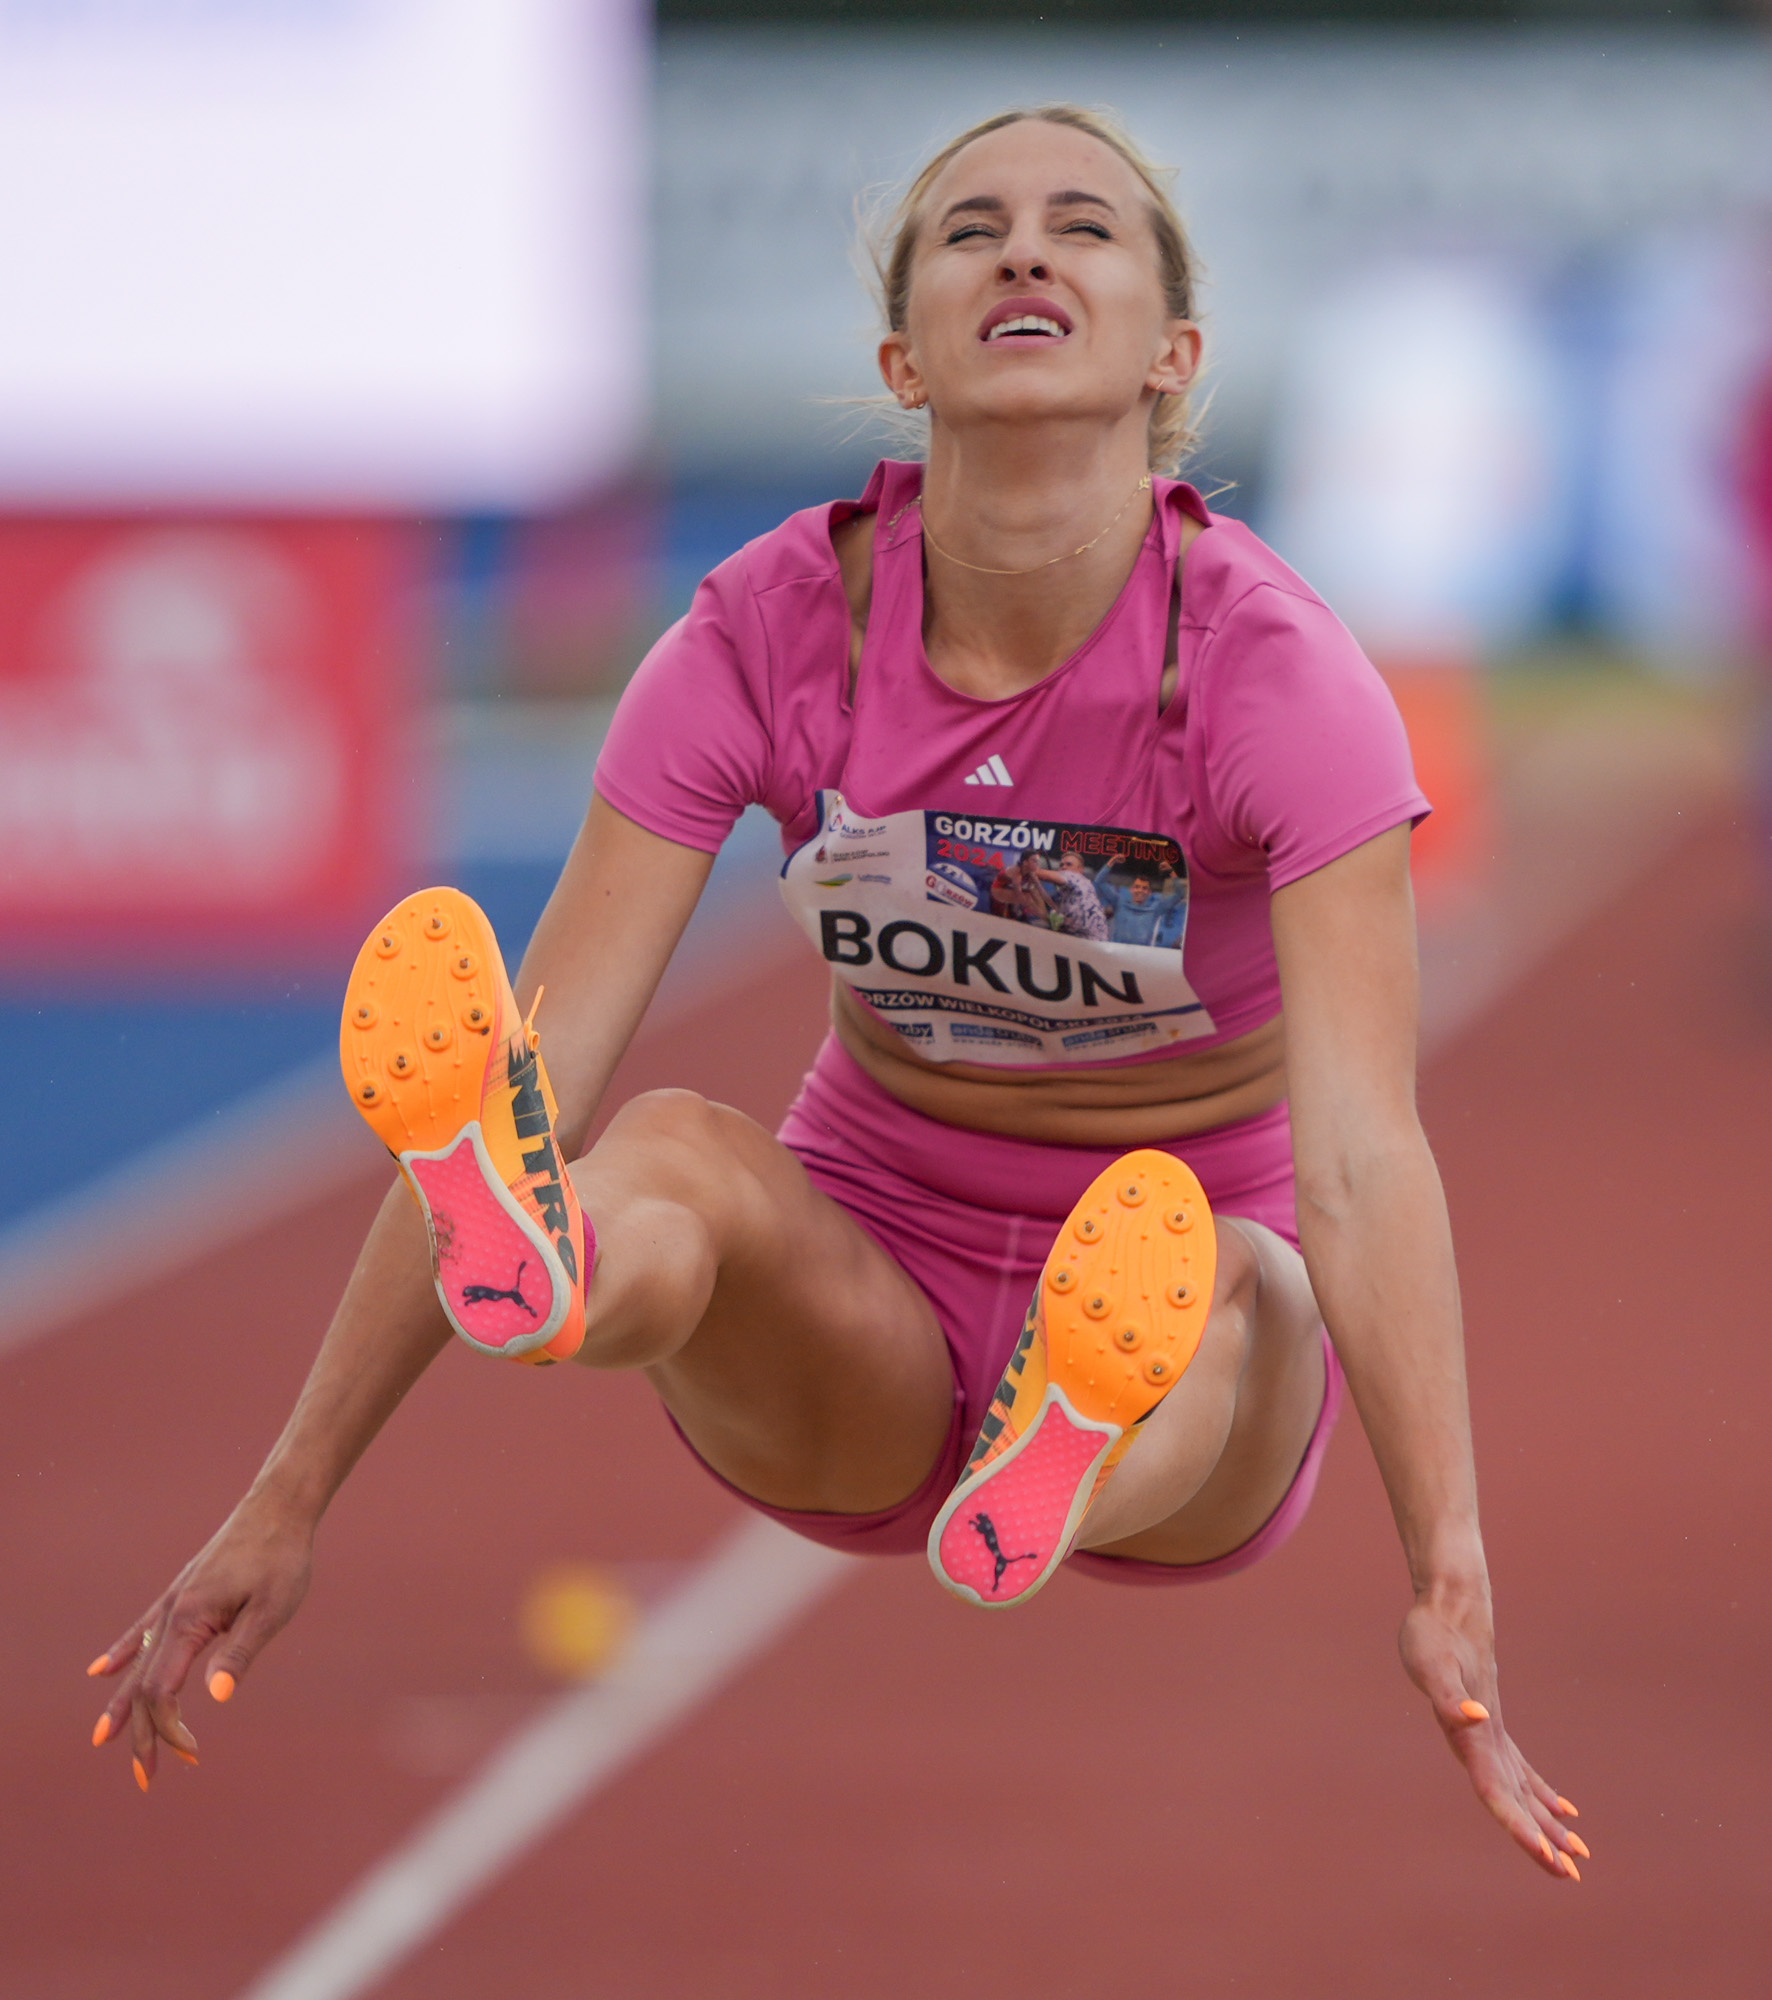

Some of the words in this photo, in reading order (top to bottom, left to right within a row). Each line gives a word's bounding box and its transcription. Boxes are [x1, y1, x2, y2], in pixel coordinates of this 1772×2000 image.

[935, 815, 1055, 850] GORZÓW
[1060, 830, 1180, 864] MEETING
[937, 838, 1004, 869] 2024
[820, 910, 1144, 1007] BOKUN
